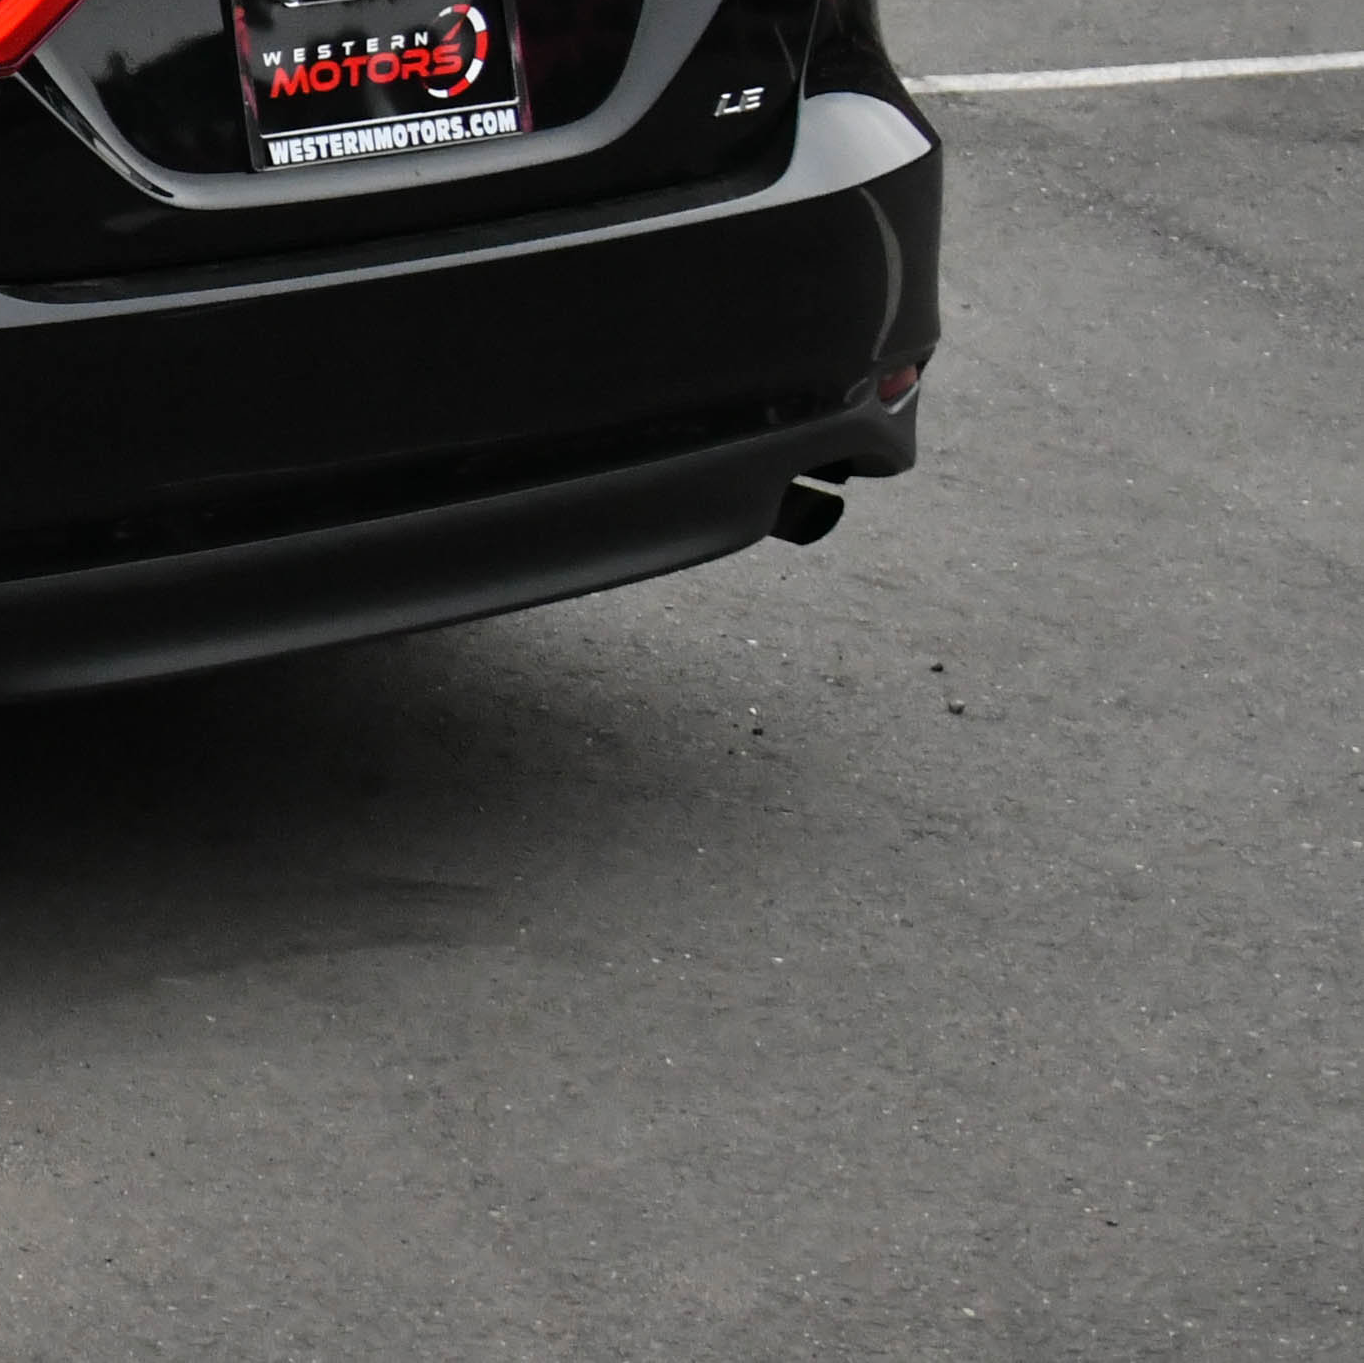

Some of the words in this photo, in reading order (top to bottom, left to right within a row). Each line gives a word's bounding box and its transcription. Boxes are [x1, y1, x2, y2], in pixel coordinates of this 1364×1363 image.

[263, 32, 429, 67] WESTERN
[270, 43, 463, 99] MOTORS
[714, 87, 764, 117] LE
[268, 108, 518, 166] WESTERNMOTORS.COM
